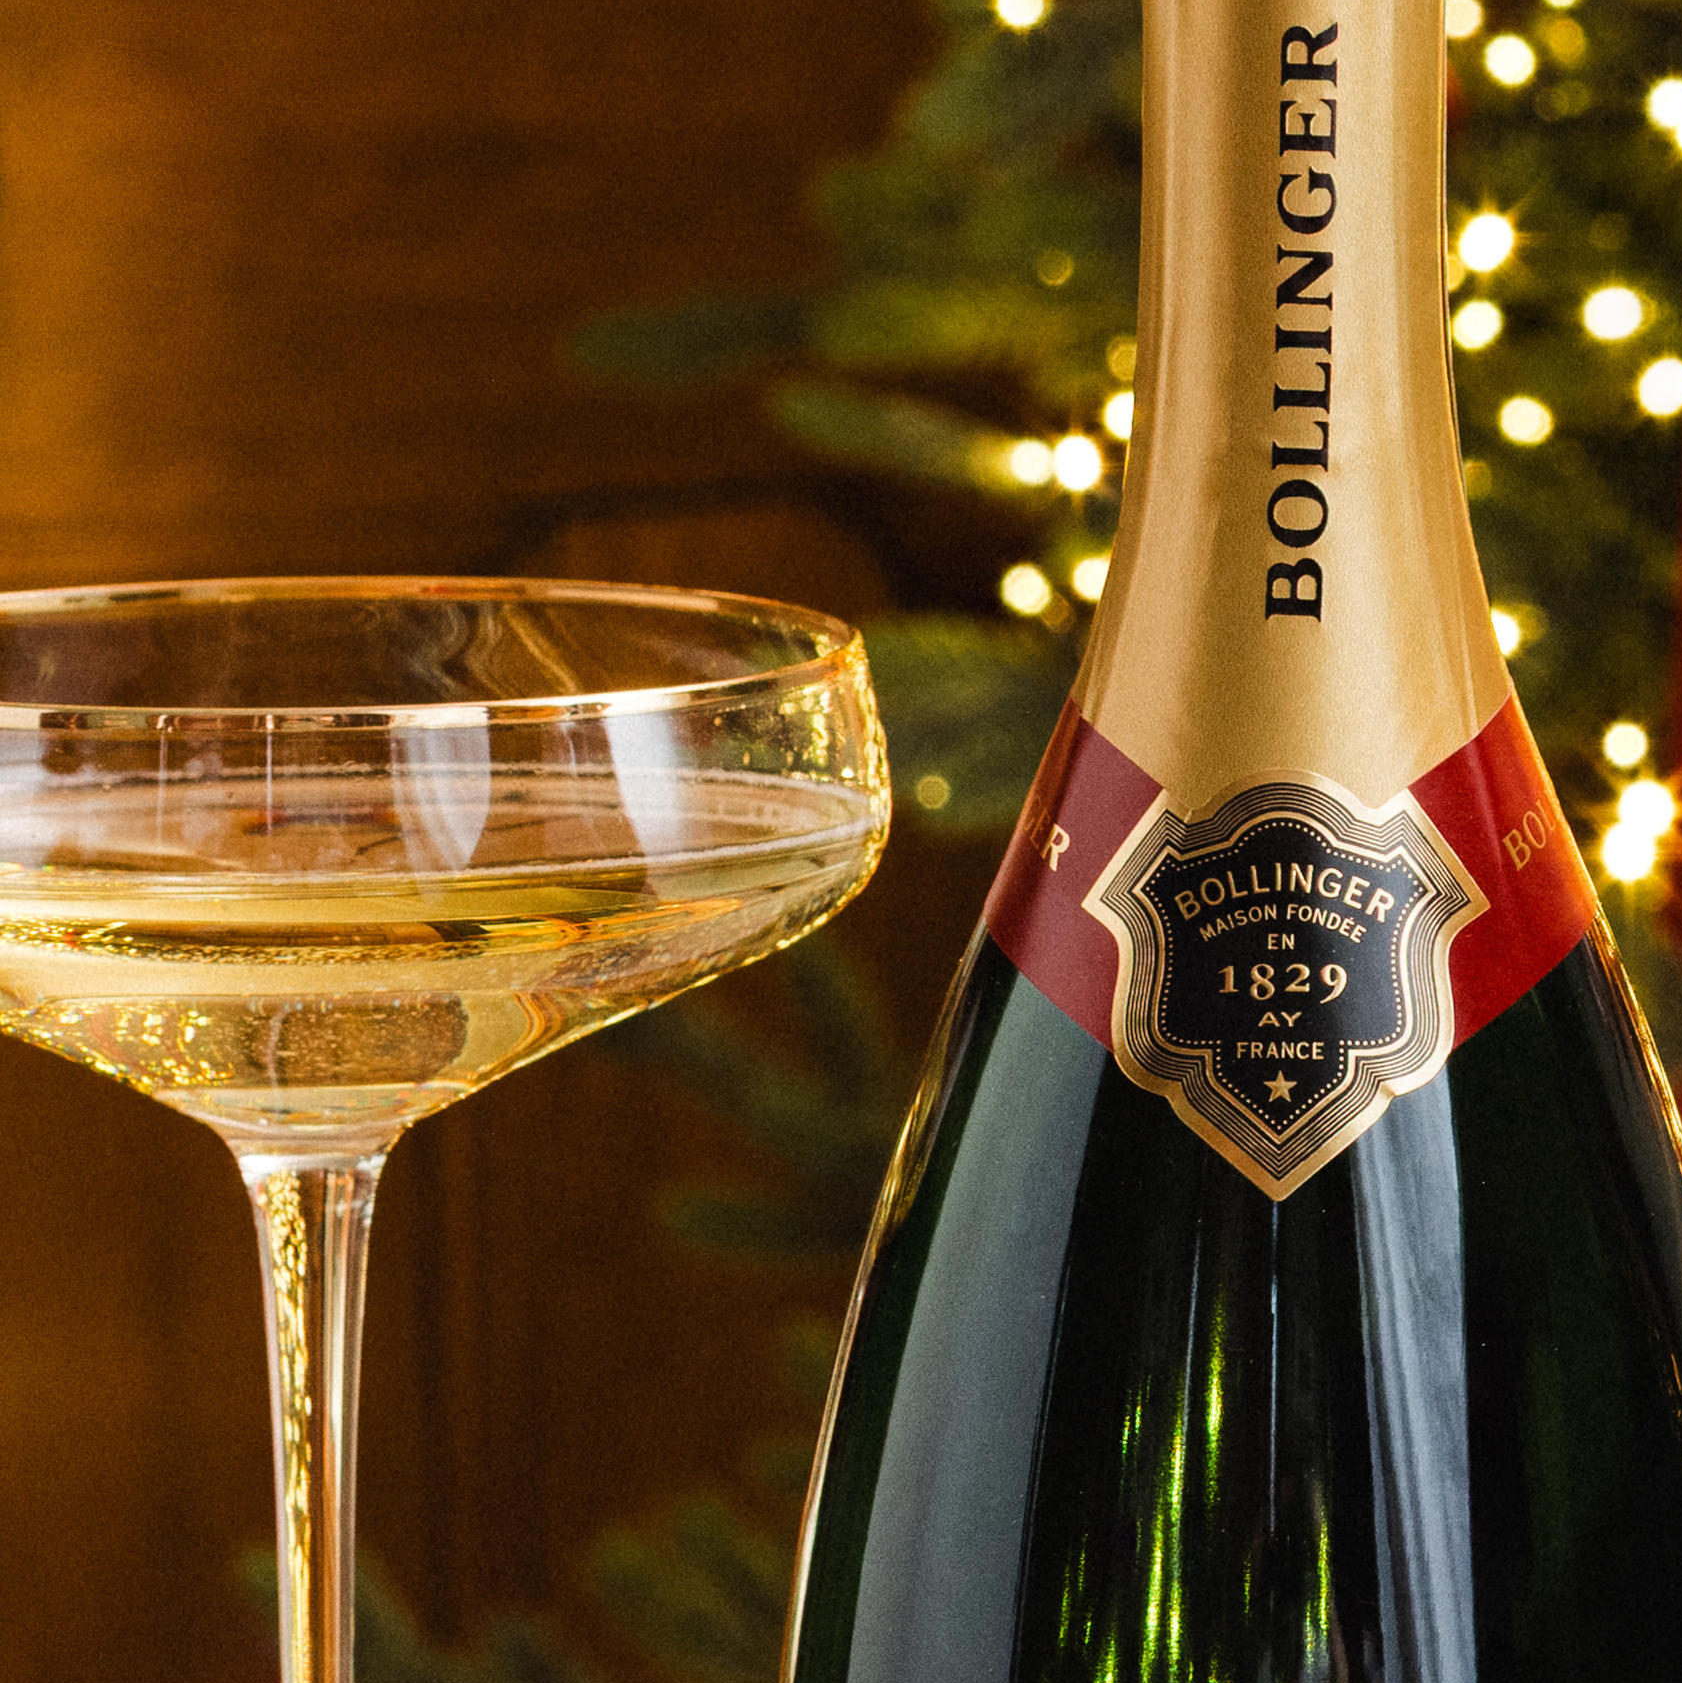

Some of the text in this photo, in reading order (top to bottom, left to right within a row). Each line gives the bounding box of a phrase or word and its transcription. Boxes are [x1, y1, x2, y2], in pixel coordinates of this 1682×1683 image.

[1264, 21, 1340, 622] BOLLINGER
[1175, 863, 1395, 923] BOLLINGER
[1199, 904, 1367, 943] MAISON FONDÉE
[1267, 934, 1295, 950] EN
[1218, 963, 1348, 1003] 1829
[1258, 1012, 1301, 1028] AY
[1236, 1041, 1324, 1061] FRANCE
